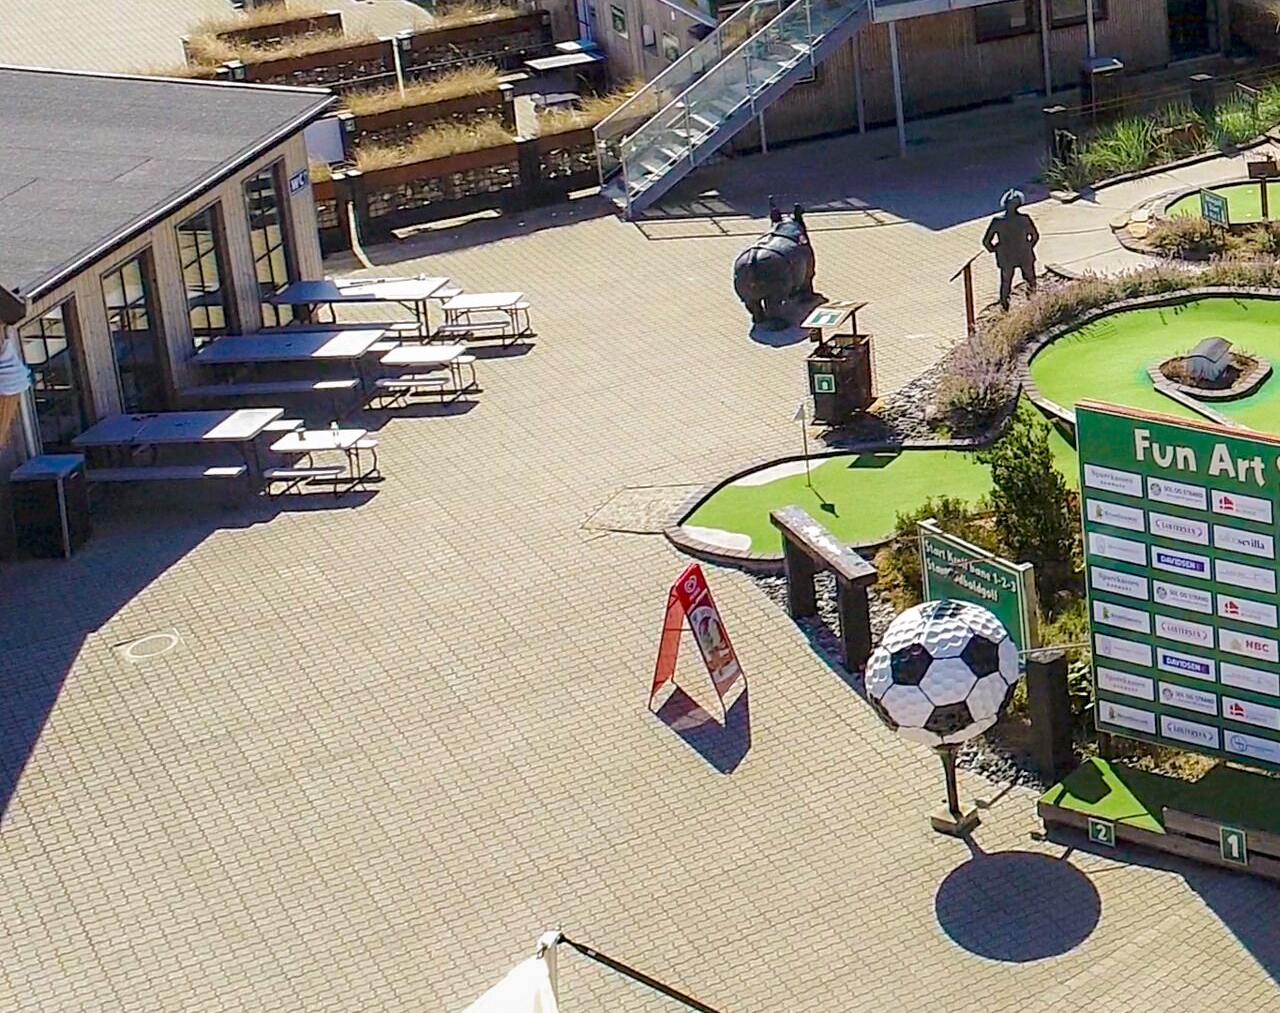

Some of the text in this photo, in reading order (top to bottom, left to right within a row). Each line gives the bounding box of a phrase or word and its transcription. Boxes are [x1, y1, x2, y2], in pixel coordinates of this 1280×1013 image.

[1134, 428, 1197, 472] Fun
[1208, 443, 1265, 487] Art
[1160, 554, 1196, 569] DAVIDSEN
[993, 572, 1016, 592] 1-2-3
[1166, 656, 1202, 672] DAVIDSEN
[1095, 824, 1108, 842] 2
[1227, 833, 1240, 858] 1
